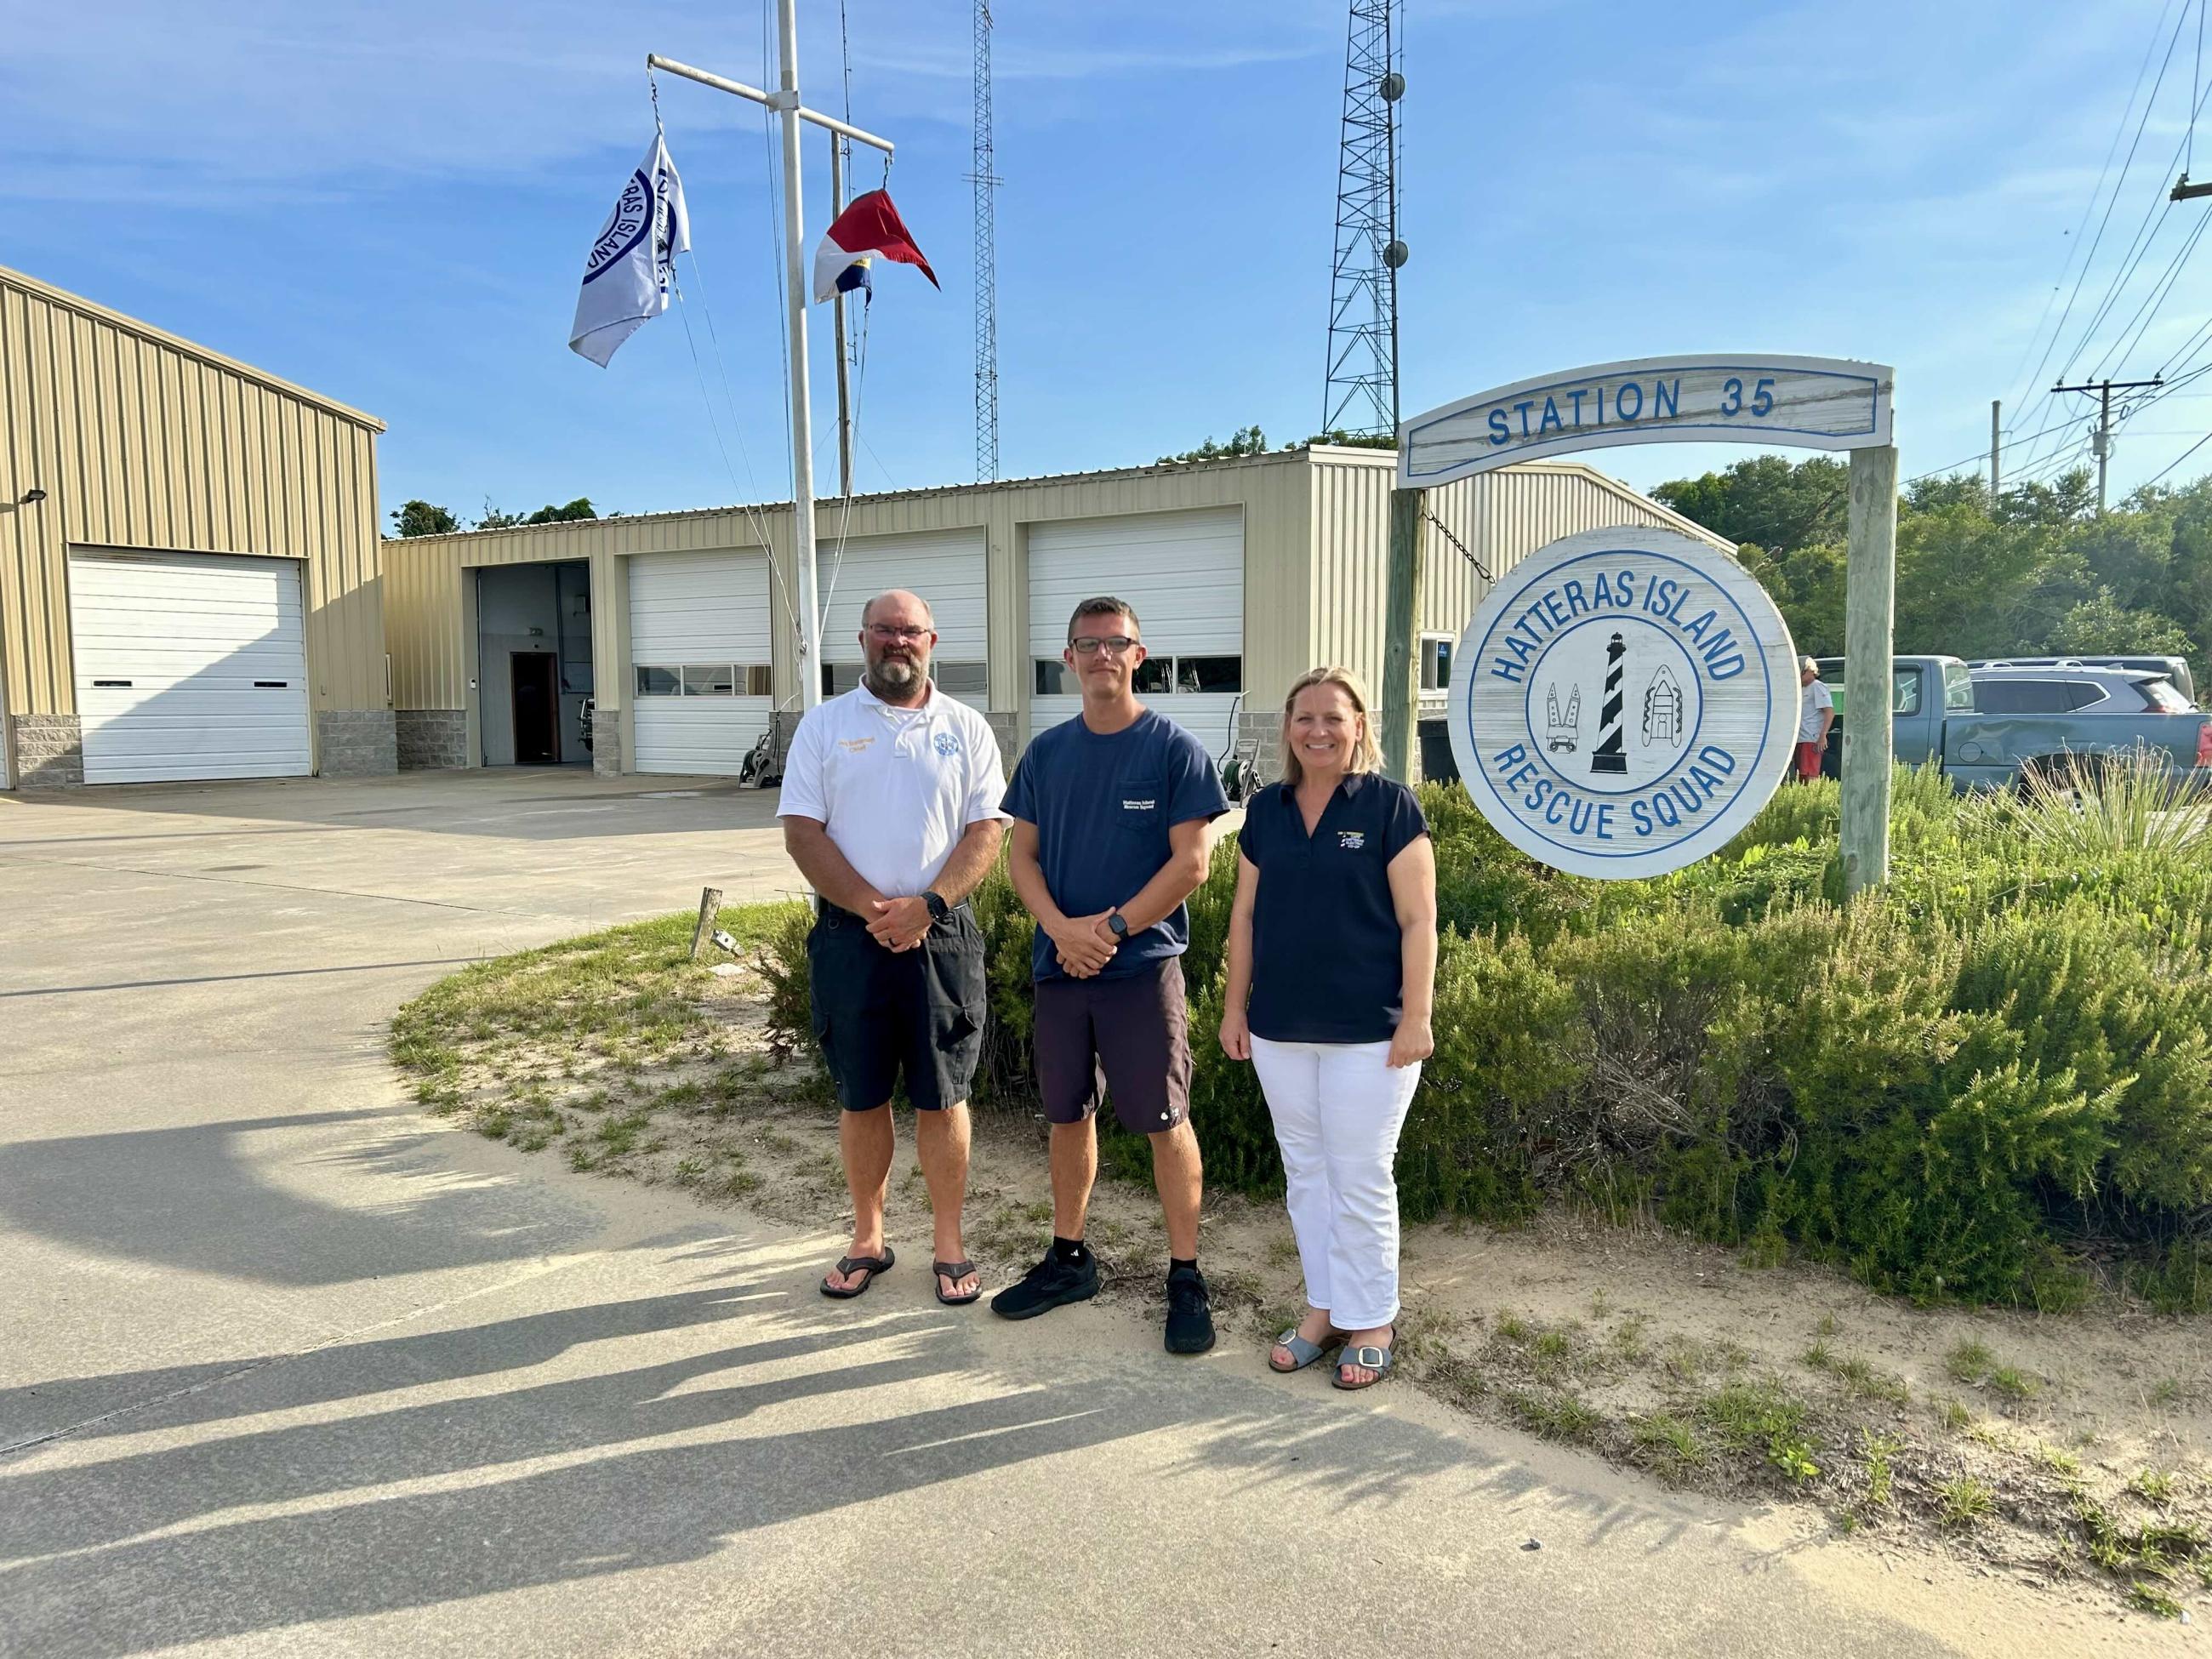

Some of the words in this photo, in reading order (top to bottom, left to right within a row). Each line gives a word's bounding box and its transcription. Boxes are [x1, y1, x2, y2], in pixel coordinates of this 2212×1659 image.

[588, 219, 639, 269] ISLAND
[1488, 379, 1679, 446] STATION
[1721, 378, 1776, 417] 35
[1491, 570, 1634, 683] HATTERAS
[1643, 574, 1745, 681] ISLAND
[1493, 743, 1615, 840] RESCUE
[1631, 745, 1736, 836] SQUAD
